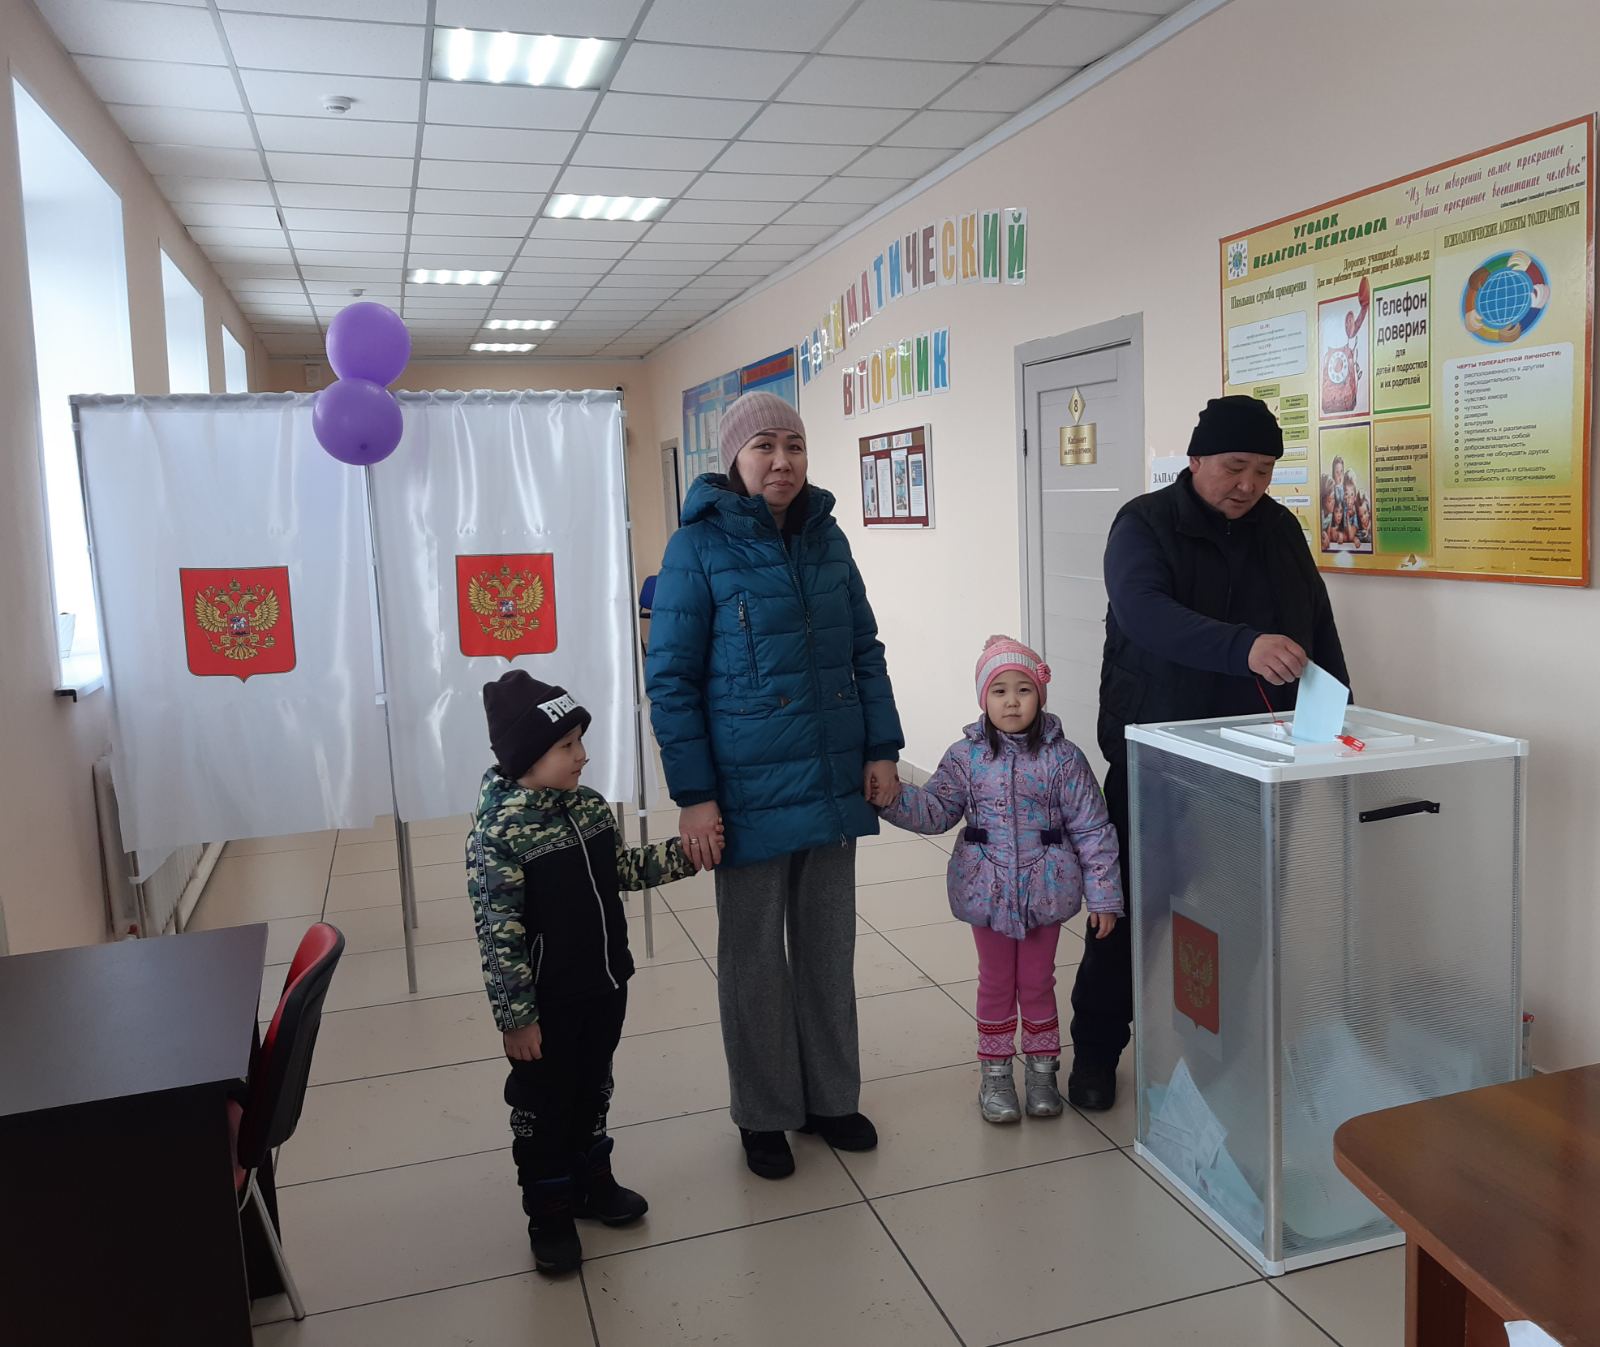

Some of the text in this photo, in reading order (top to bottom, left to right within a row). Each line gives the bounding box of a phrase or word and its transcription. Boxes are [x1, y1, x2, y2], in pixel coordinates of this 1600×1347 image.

[1445, 168, 1482, 189] творений
[1488, 162, 1511, 177] самое
[1517, 145, 1563, 170] прекрасное
[1395, 203, 1439, 228] получивший
[1444, 191, 1485, 214] прекрасное
[1492, 175, 1540, 198] воспитание
[1294, 213, 1339, 239] УГОЛОК
[1444, 201, 1580, 248] ПСИХОЛОГИЧЕСКИЕ АСПЕКТЫ ТОЛЕРАНТНОСТИ
[1253, 217, 1387, 269] ПЕДАГОГА-ПСИХОЛОГА
[1343, 245, 1398, 272] Дорогие учащиеся!
[1231, 281, 1306, 309] Школьная служба примирения
[1376, 291, 1427, 317] Телефон
[1377, 319, 1426, 346] доверия
[1395, 348, 1406, 358] для
[1478, 356, 1522, 367] ТОЛЕРАНТНОЙ
[843, 330, 948, 416] ВТОРНИК
[1376, 363, 1391, 377] детей
[1397, 361, 1428, 374] подростков
[1392, 375, 1420, 389] родителей
[1074, 399, 1078, 412] 8
[1153, 472, 1180, 483] ЗАПАС
